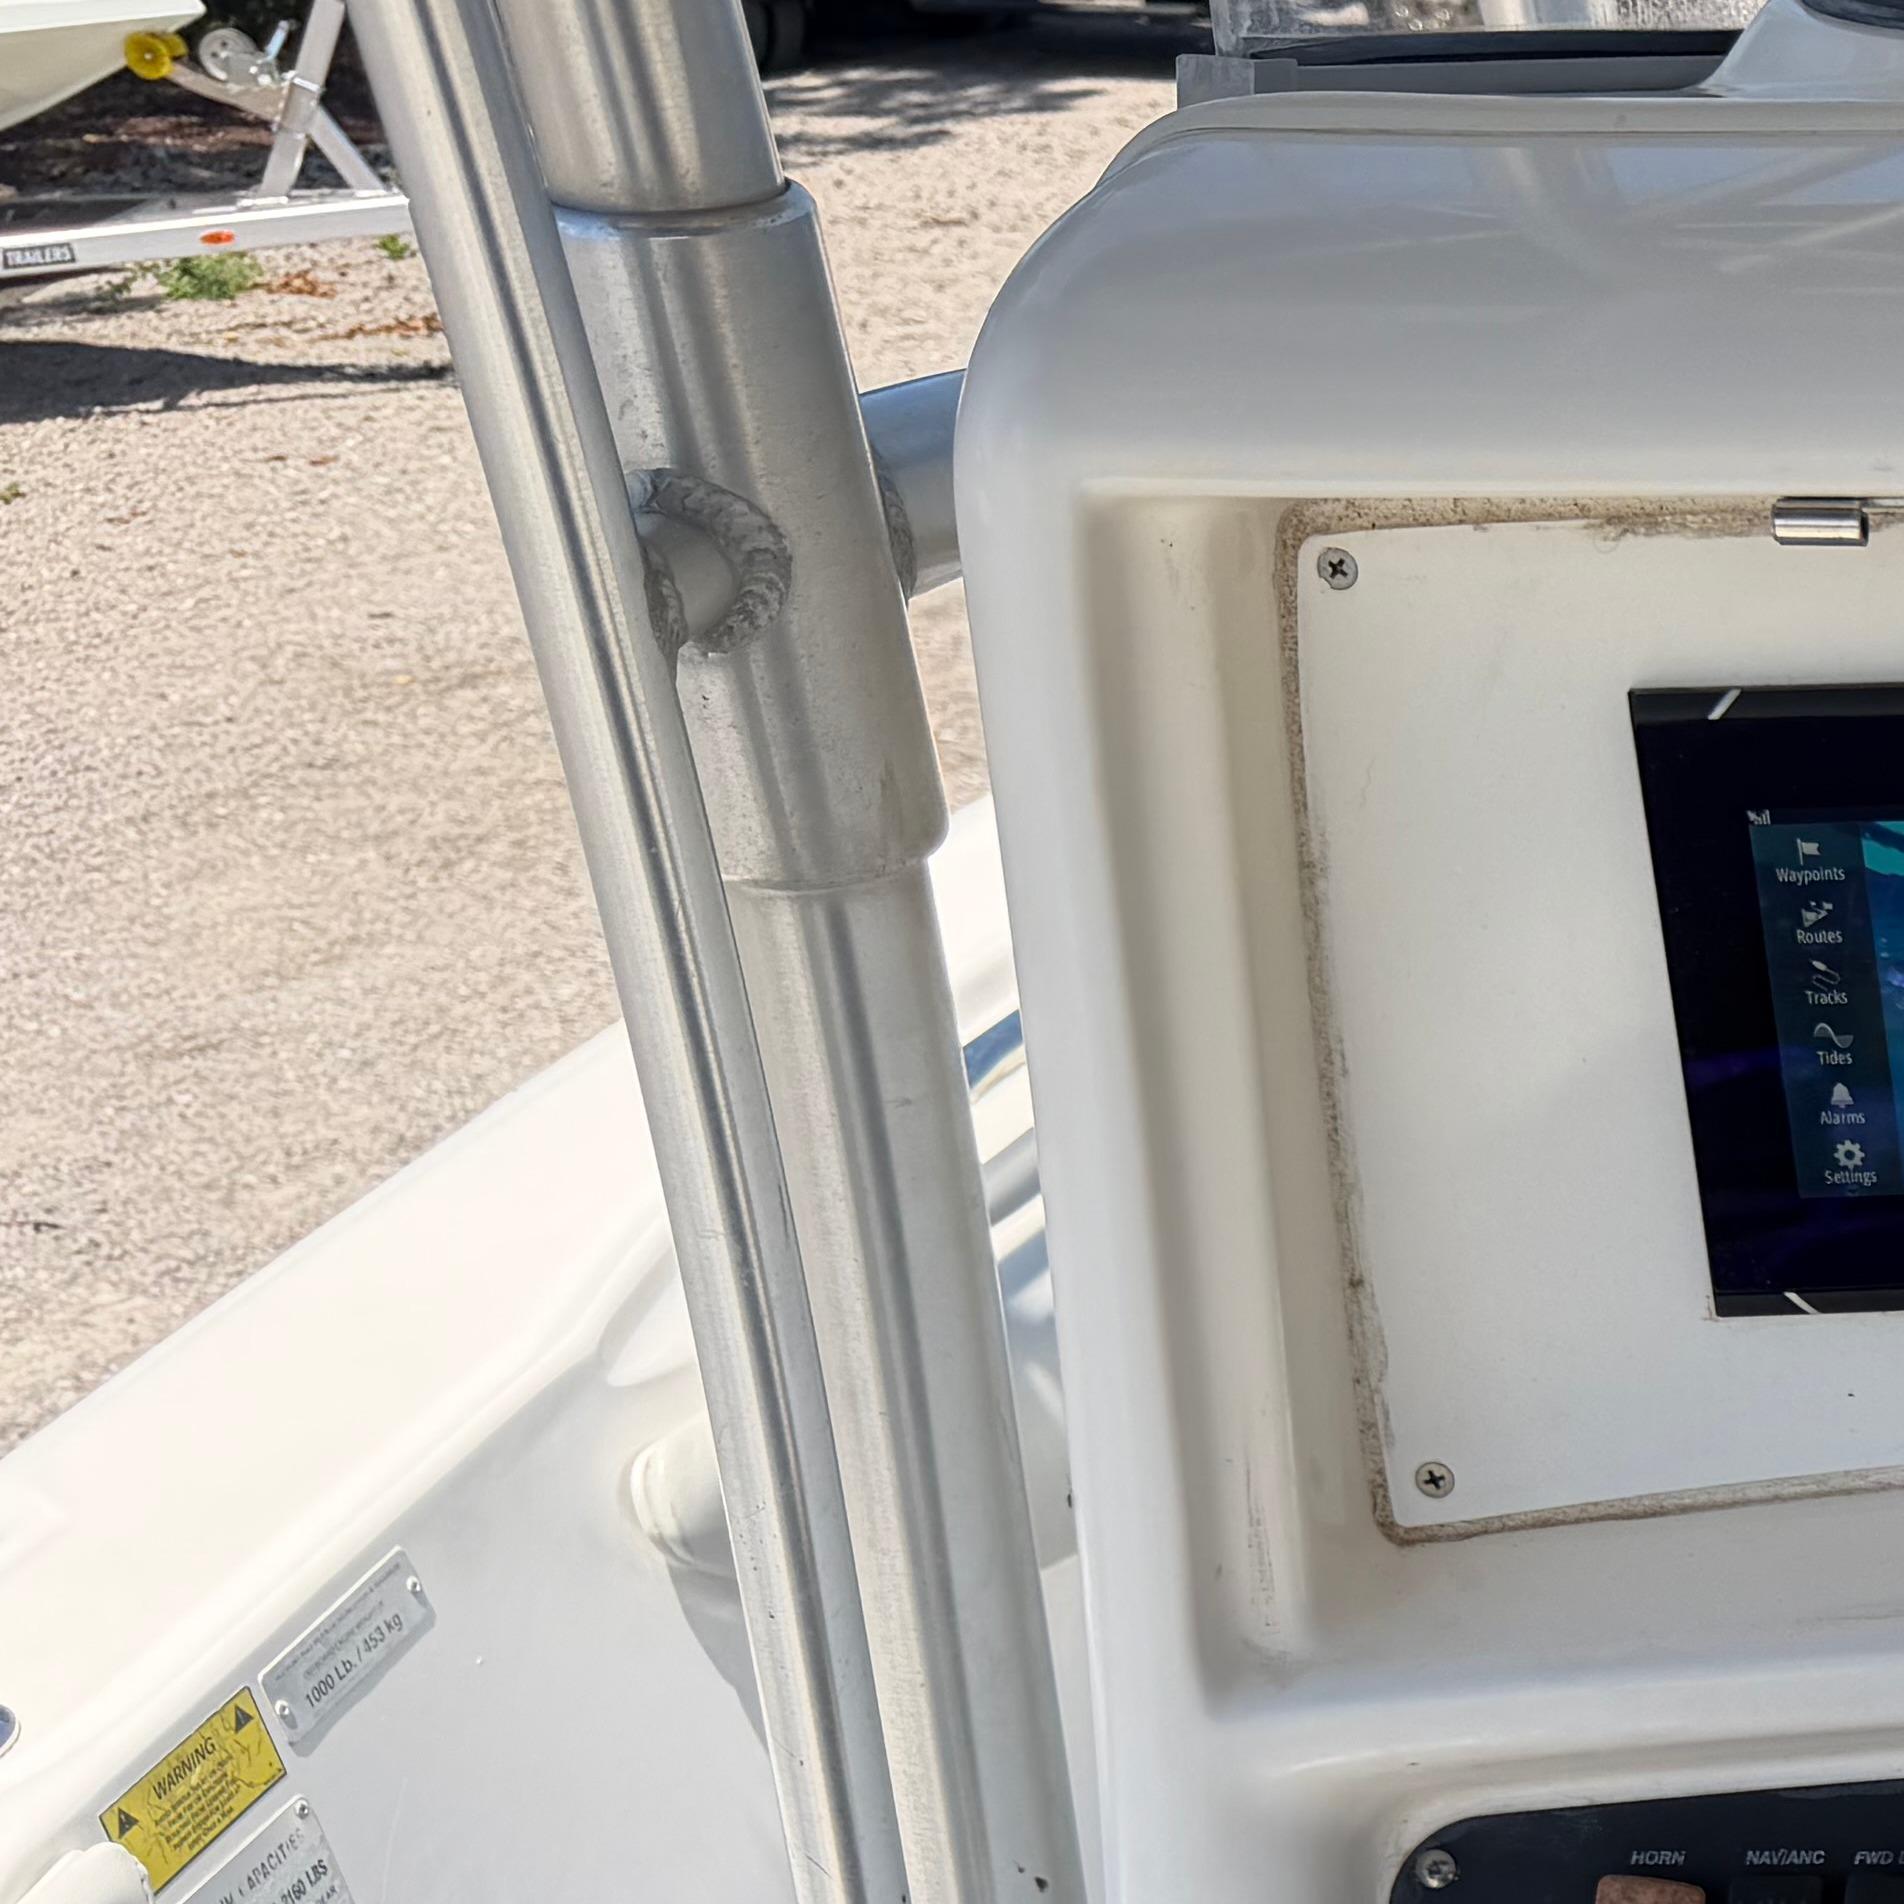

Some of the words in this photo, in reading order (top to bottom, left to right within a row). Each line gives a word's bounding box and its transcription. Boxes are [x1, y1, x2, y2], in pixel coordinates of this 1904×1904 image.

[1776, 867, 1846, 886] Waypoints
[1797, 929, 1843, 945] Routes
[1805, 990, 1848, 1006] Tracks
[1816, 1050, 1853, 1066] Tides
[1820, 1110, 1865, 1126] Alarms
[1824, 1169, 1877, 1186] Settings
[305, 1673, 335, 1708] 1000
[334, 1659, 357, 1681] Lb.
[363, 1625, 387, 1652] 453
[384, 1613, 404, 1634] kg
[151, 1735, 217, 1801] WARNING
[1630, 1849, 1687, 1867] HORN
[1744, 1849, 1826, 1867] NAV/ANC
[1854, 1849, 1895, 1867] FWD
[305, 1858, 328, 1888] LBS
